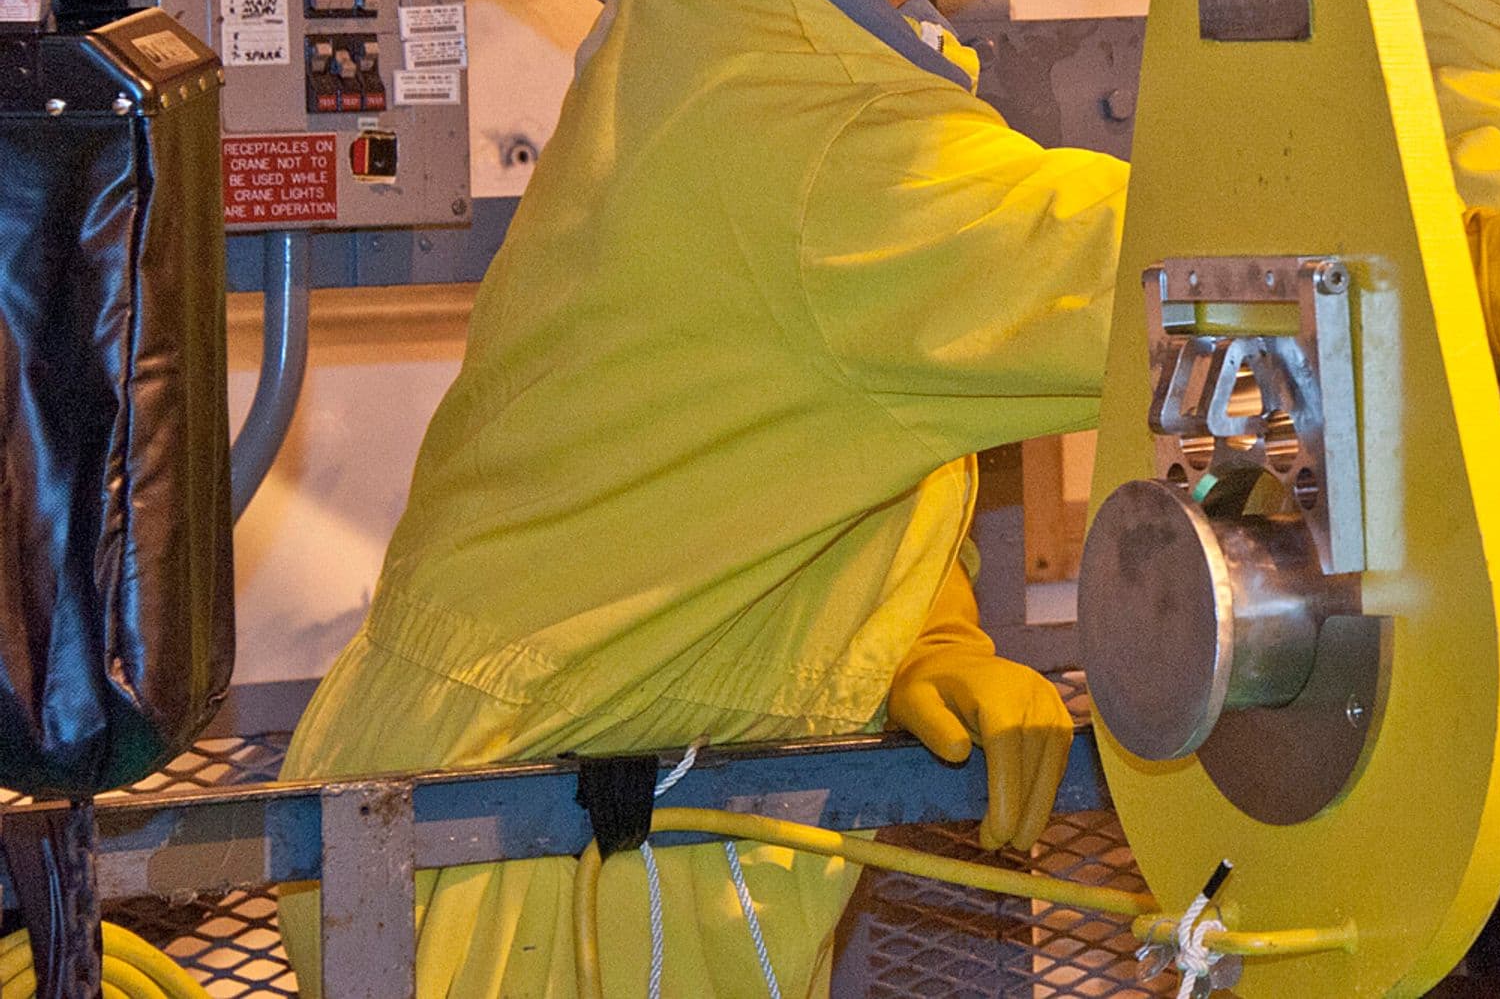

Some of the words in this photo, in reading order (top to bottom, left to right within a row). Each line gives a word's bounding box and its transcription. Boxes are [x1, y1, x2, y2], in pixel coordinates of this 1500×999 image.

[223, 141, 309, 156] RECEPTACLES
[315, 140, 334, 153] ON
[230, 157, 271, 171] CRANE
[277, 156, 302, 170] NOT
[310, 155, 328, 168] TO
[228, 174, 246, 187] BE
[252, 172, 285, 186] USED
[290, 170, 328, 185] WHILE
[233, 188, 275, 202] CRANE
[280, 186, 325, 201] LIGHTS
[223, 205, 247, 218] ARE
[253, 204, 266, 217] IN
[270, 201, 336, 216] OPERATION
